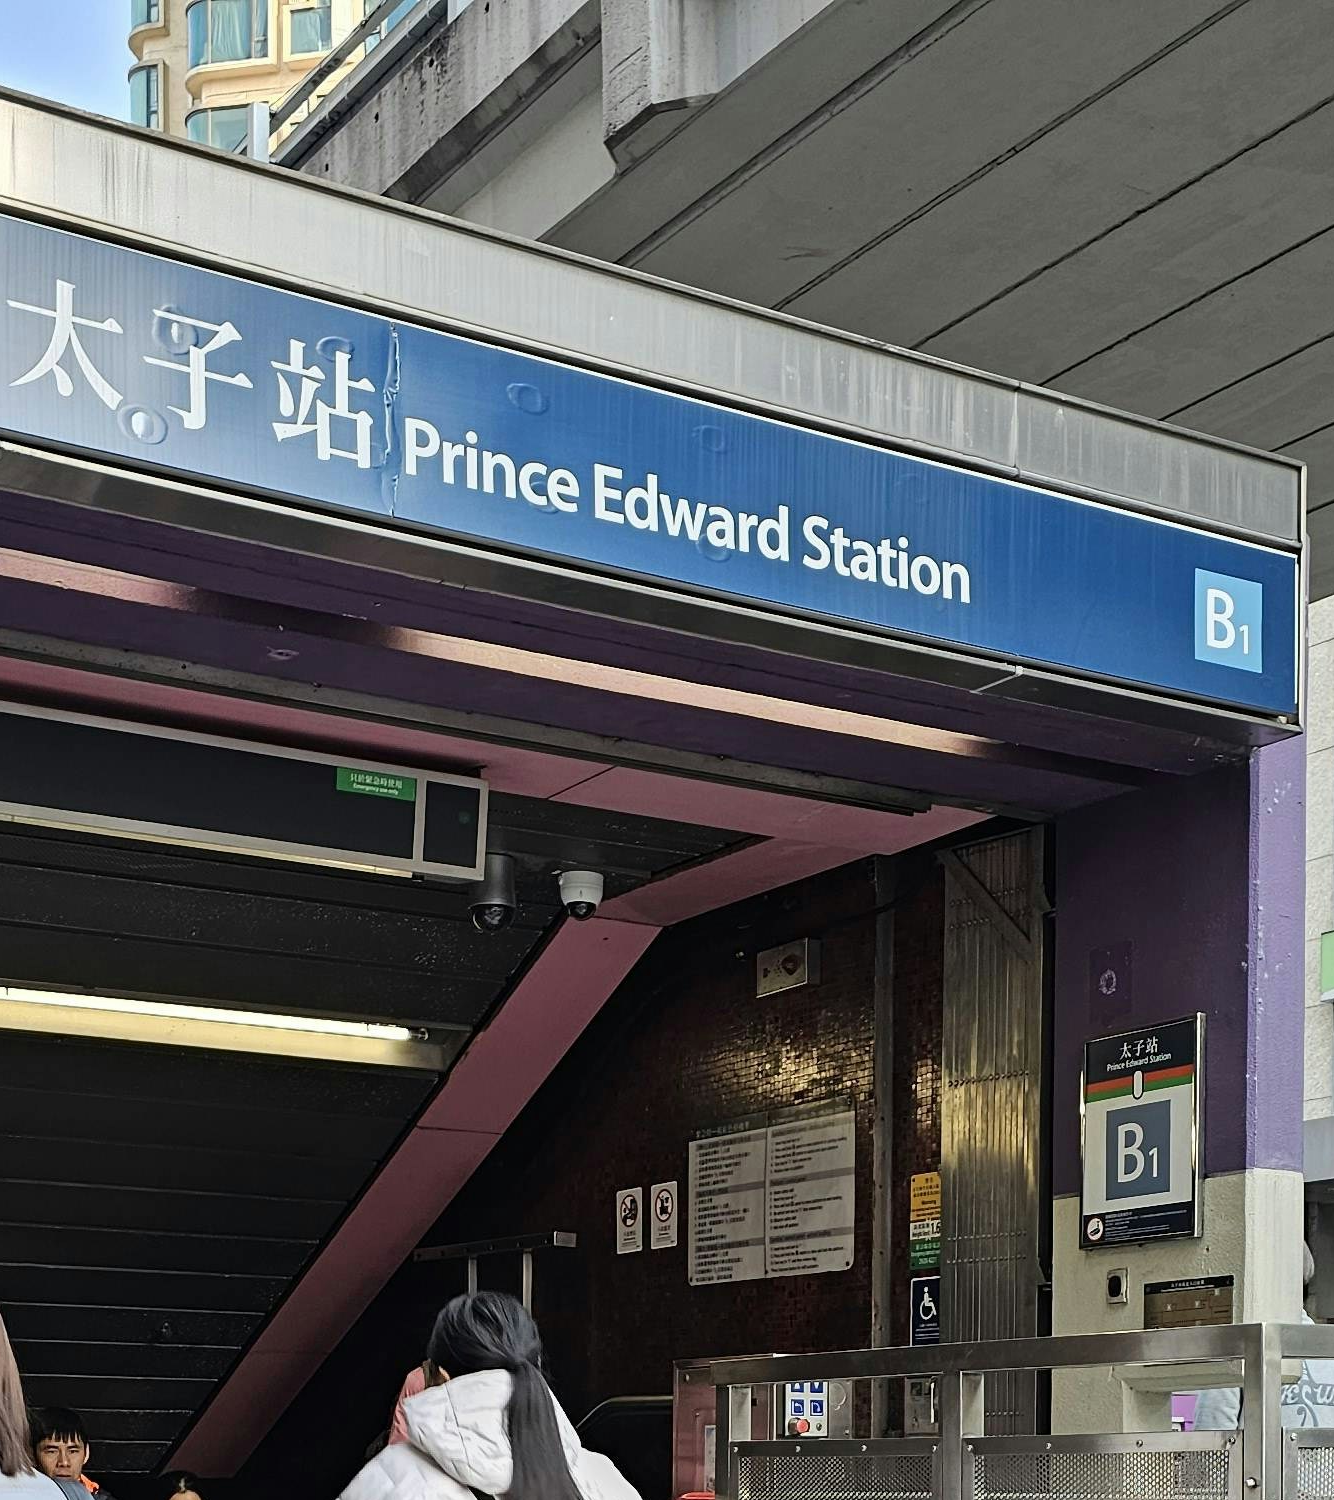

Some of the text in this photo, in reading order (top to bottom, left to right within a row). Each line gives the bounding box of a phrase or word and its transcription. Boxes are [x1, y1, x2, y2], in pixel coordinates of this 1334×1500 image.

[7, 280, 375, 472] 太子站
[402, 412, 973, 605] Prince Edward Station
[1107, 1052, 1172, 1072] Prince Edward Station
[1119, 1036, 1159, 1060] 太子站
